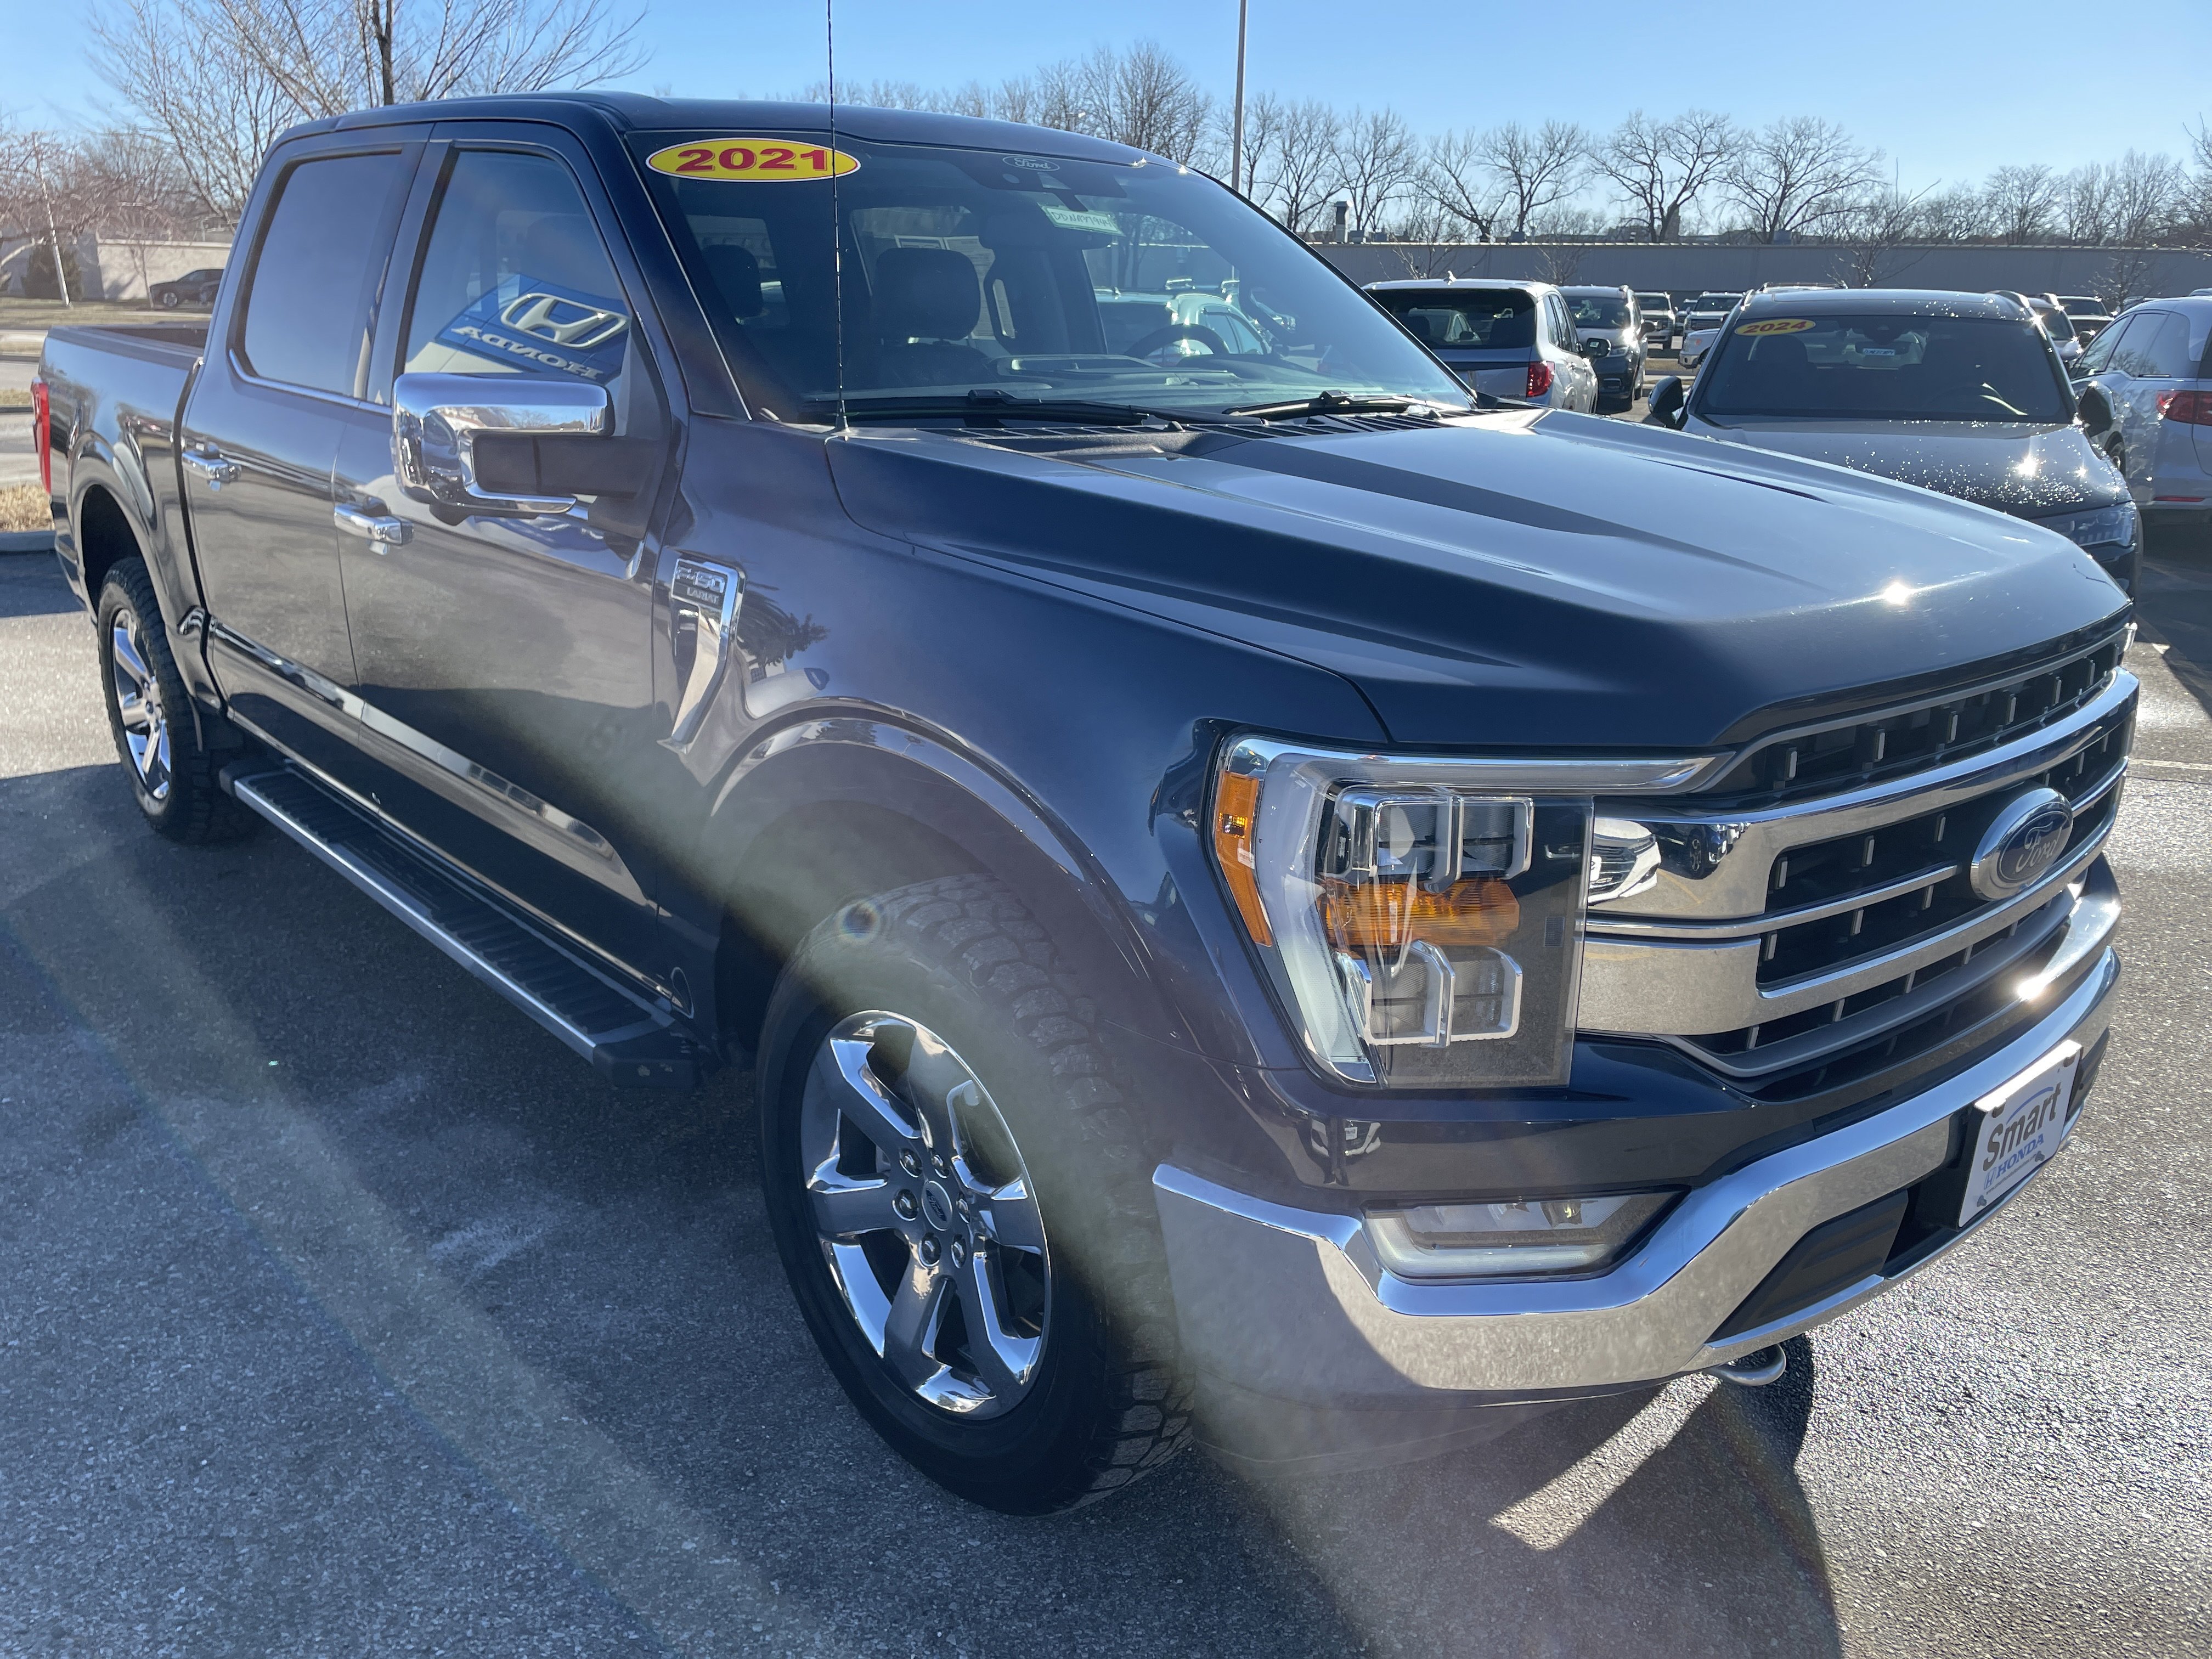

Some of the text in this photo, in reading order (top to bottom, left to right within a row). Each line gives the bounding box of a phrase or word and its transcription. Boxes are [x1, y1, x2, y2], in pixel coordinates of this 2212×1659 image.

[676, 148, 827, 172] 2021
[1014, 157, 1051, 170] Ford
[1743, 321, 1807, 334] 2024
[2014, 821, 2062, 873] Ford
[1983, 1082, 2062, 1172] Smart
[1996, 1133, 2045, 1179] HONDA
